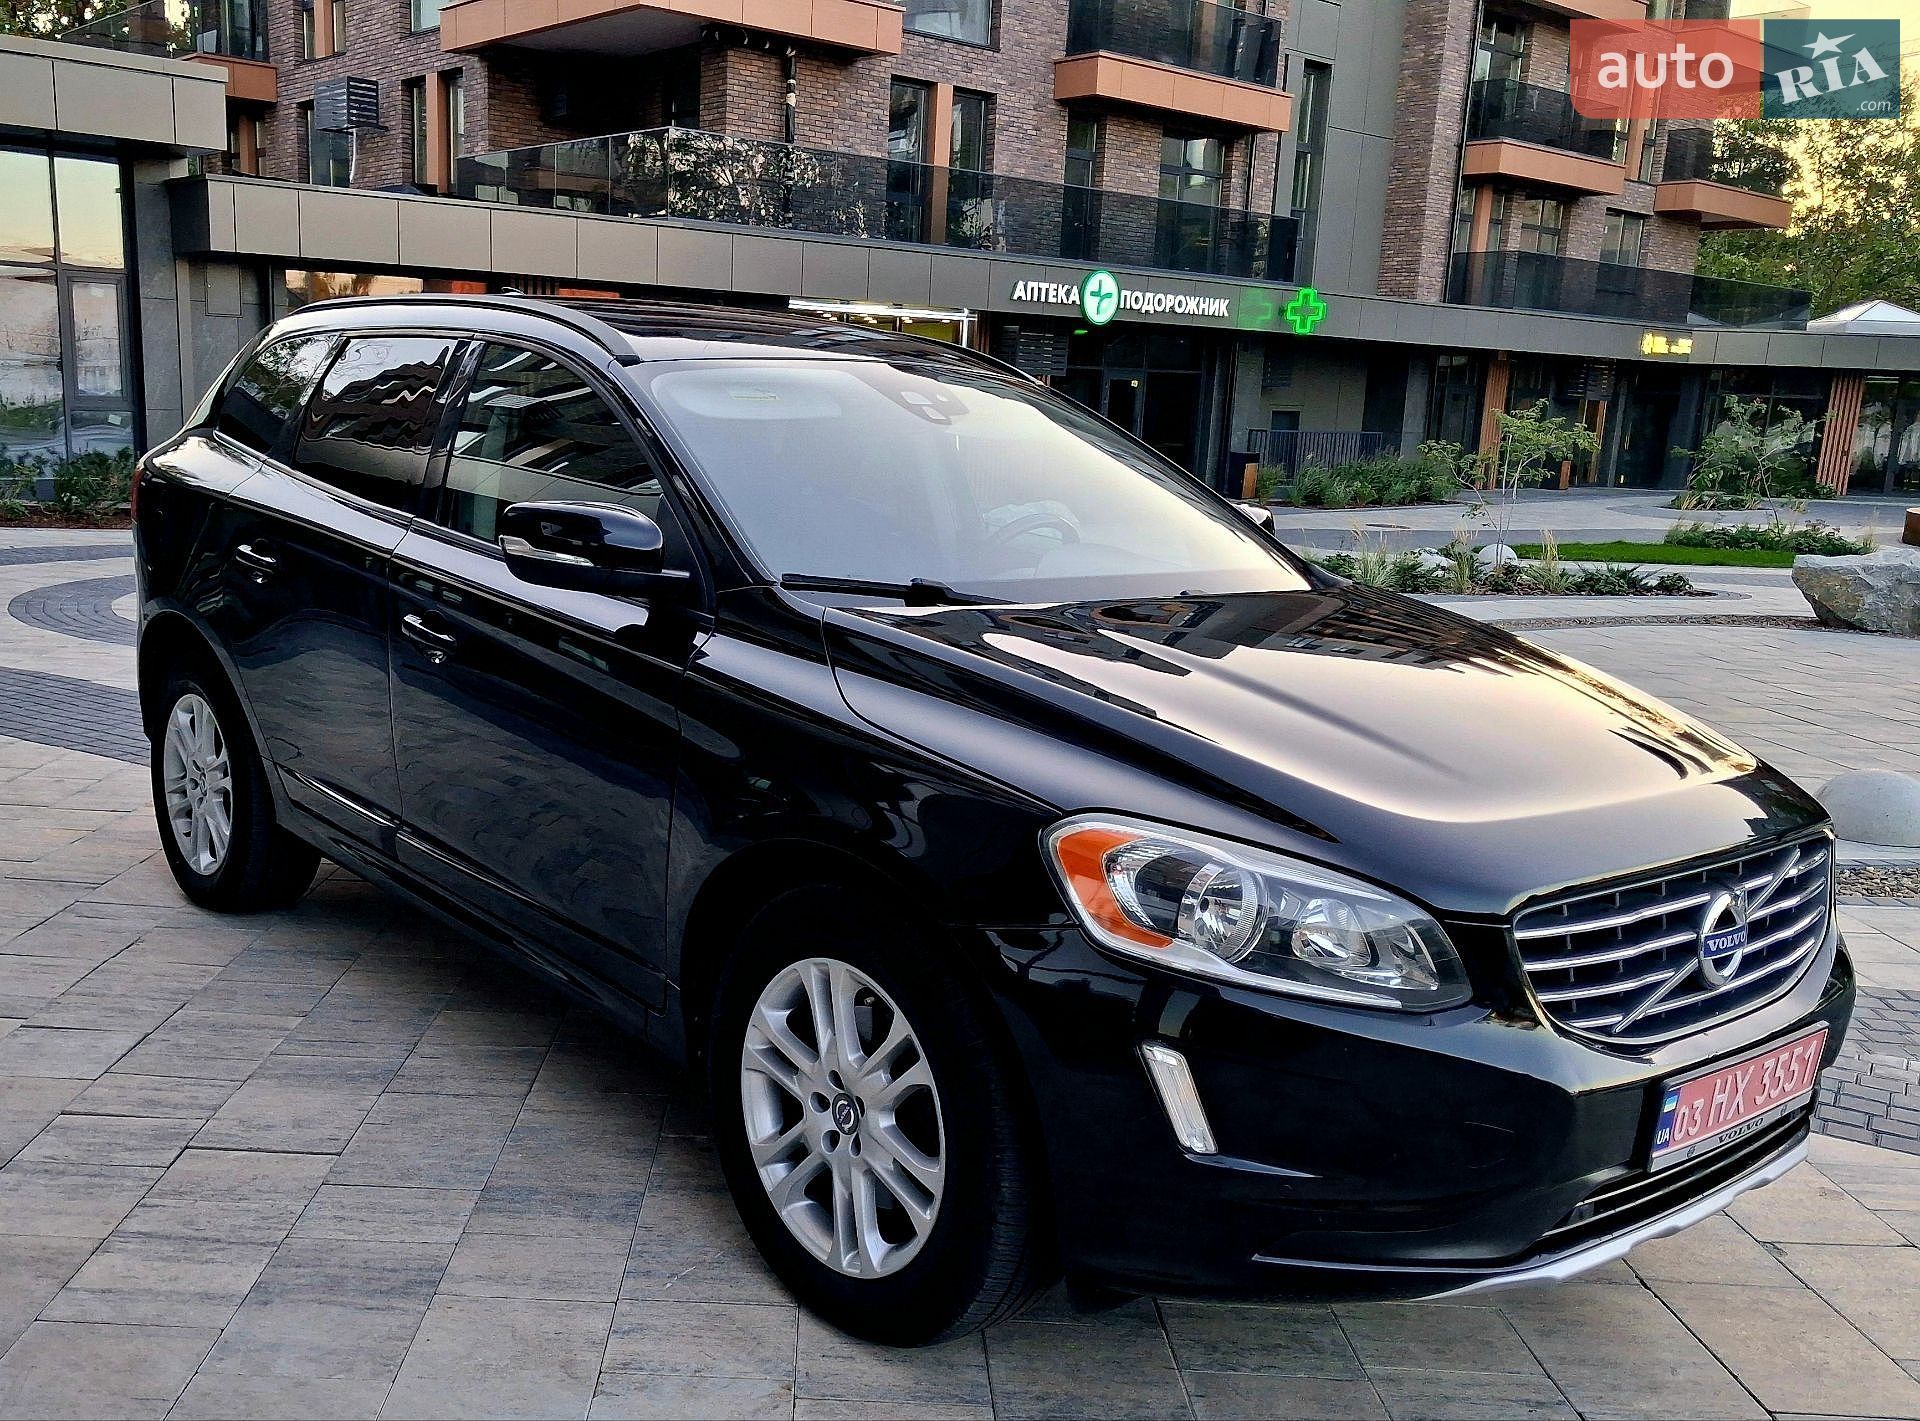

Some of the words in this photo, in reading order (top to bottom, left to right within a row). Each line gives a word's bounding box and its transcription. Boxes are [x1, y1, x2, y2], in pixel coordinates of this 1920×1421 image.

[1012, 280, 1080, 304] АПТЕКА
[1119, 290, 1230, 317] ПОДОРОЖНИК
[1707, 931, 1746, 952] VOLVO
[1673, 1098, 1704, 1142] 03
[1708, 1065, 1755, 1127] HX
[1754, 1040, 1818, 1105] 3551
[1656, 1129, 1670, 1145] UA
[1718, 1117, 1764, 1143] VOLVO
